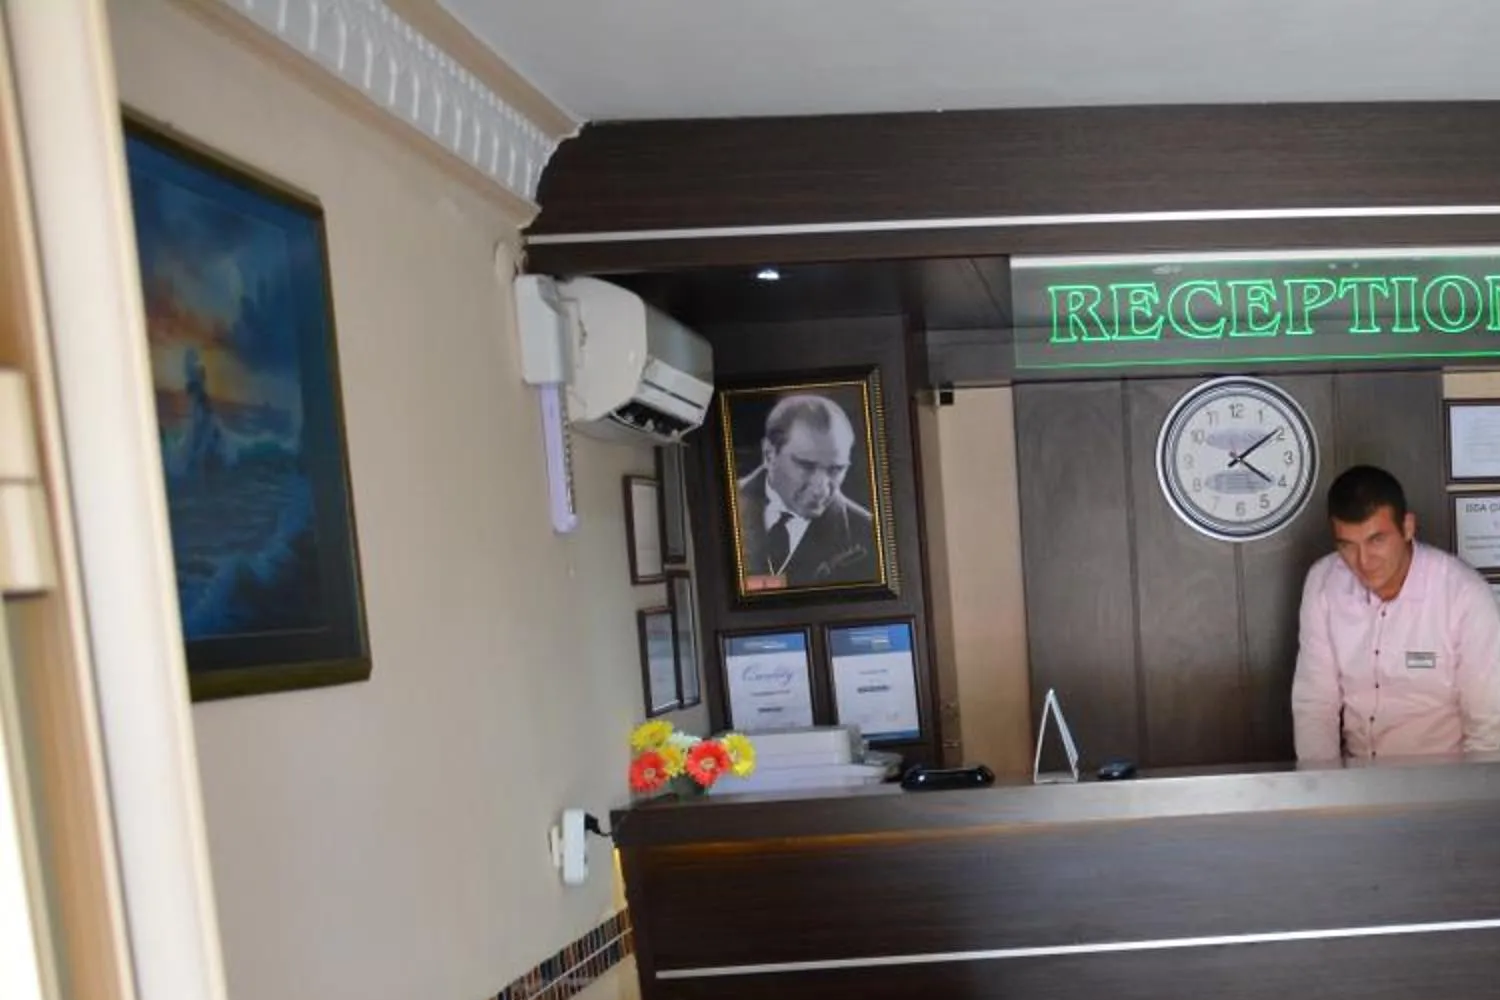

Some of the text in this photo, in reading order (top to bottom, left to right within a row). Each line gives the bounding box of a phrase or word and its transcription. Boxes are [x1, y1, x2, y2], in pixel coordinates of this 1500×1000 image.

[1229, 403, 1244, 418] 12
[1284, 451, 1294, 464] 3
[1259, 494, 1270, 508] 5
[1235, 502, 1246, 516] 6
